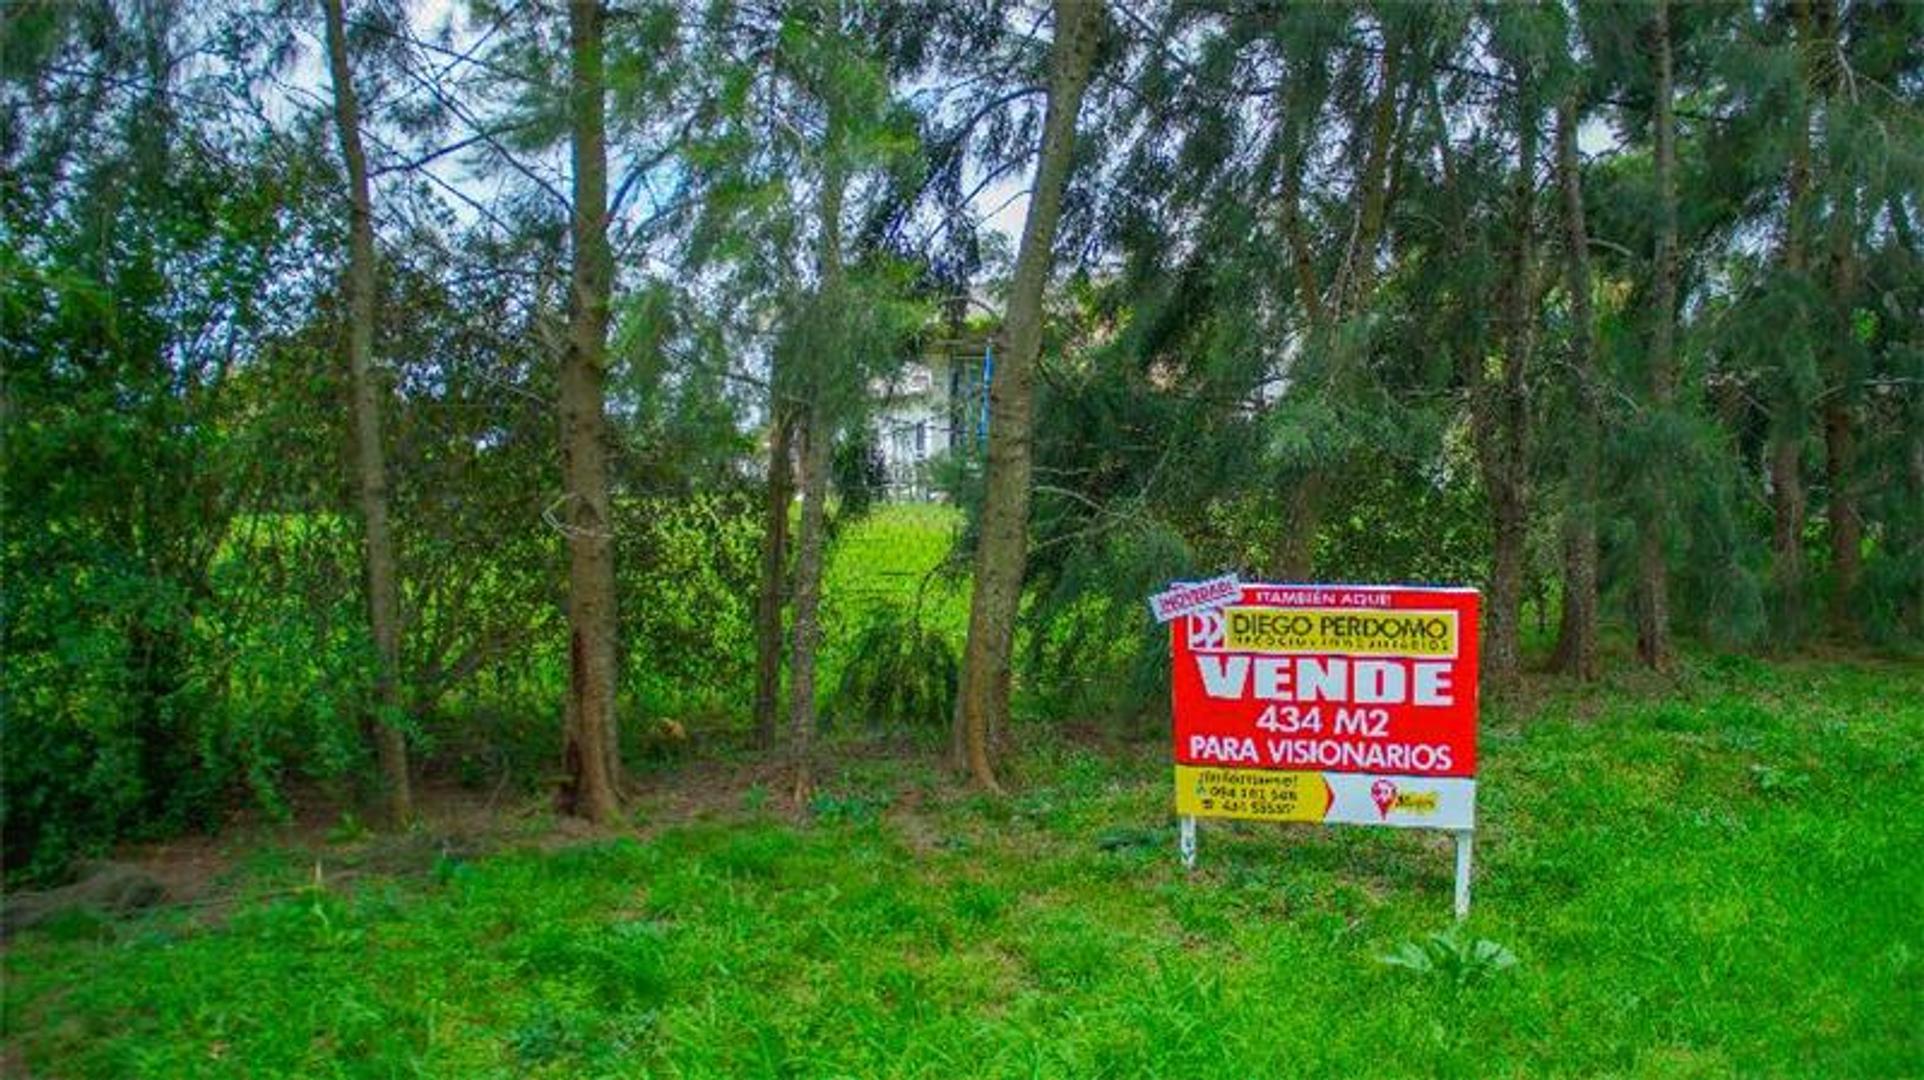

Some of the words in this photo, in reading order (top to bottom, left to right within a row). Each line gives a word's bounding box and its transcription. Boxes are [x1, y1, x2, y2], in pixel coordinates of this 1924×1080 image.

[1233, 613, 1313, 636] DIEGO
[1320, 616, 1448, 640] PERDOMO
[1196, 654, 1455, 706] VENDE
[1256, 704, 1323, 733] 434
[1333, 709, 1389, 737] M2
[1190, 735, 1260, 763] PARA
[1267, 739, 1453, 771] VISIONARIOS
